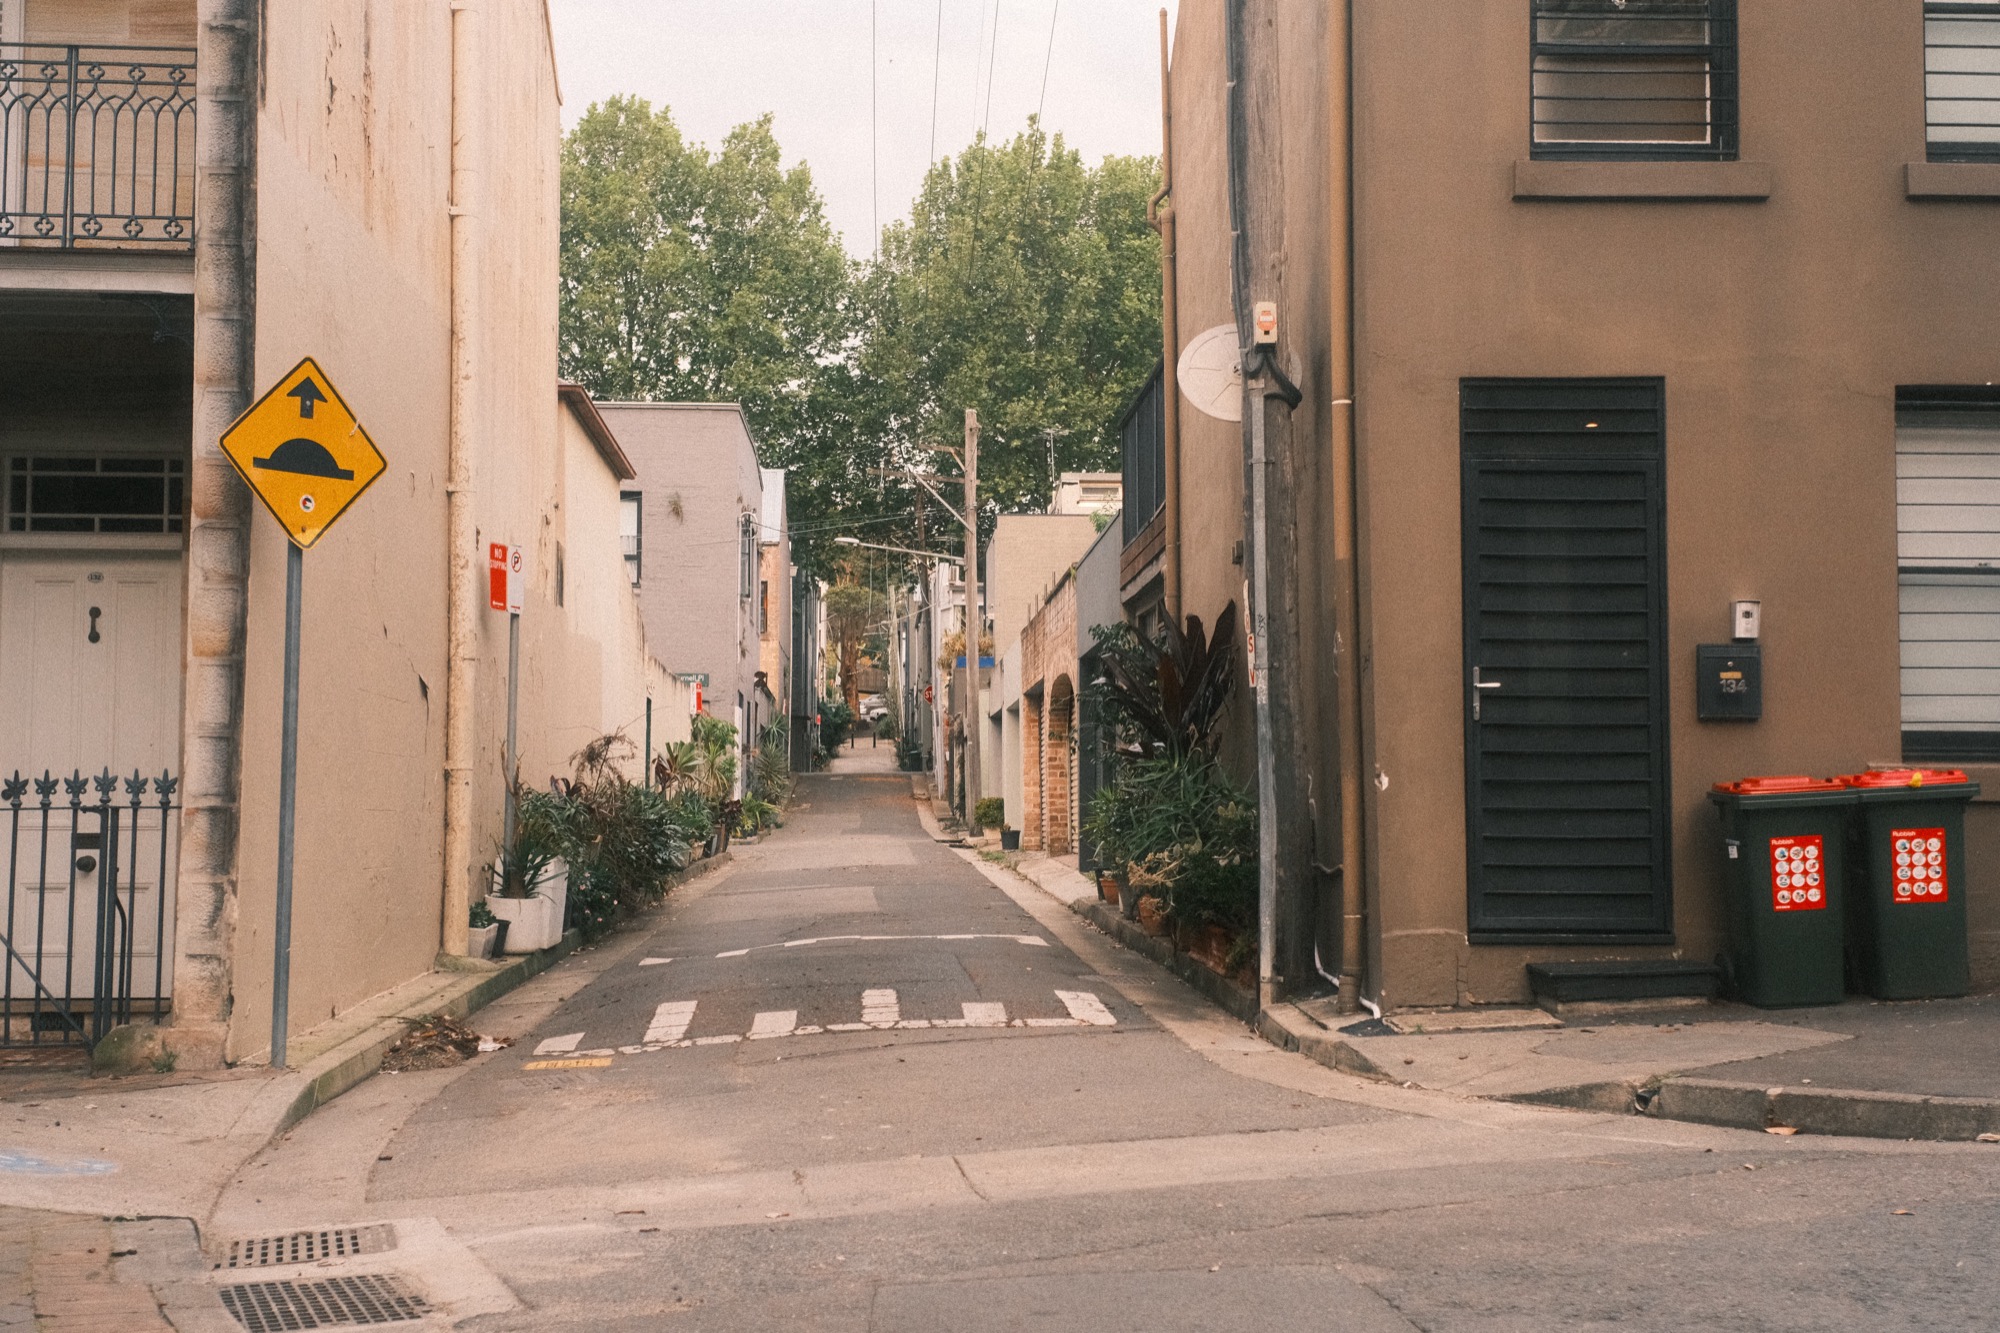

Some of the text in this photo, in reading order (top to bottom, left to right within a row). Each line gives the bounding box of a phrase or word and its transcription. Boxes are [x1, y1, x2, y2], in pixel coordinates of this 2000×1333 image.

[494, 547, 503, 560] NO
[1719, 679, 1748, 693] 134
[1771, 838, 1795, 846] Rubbish
